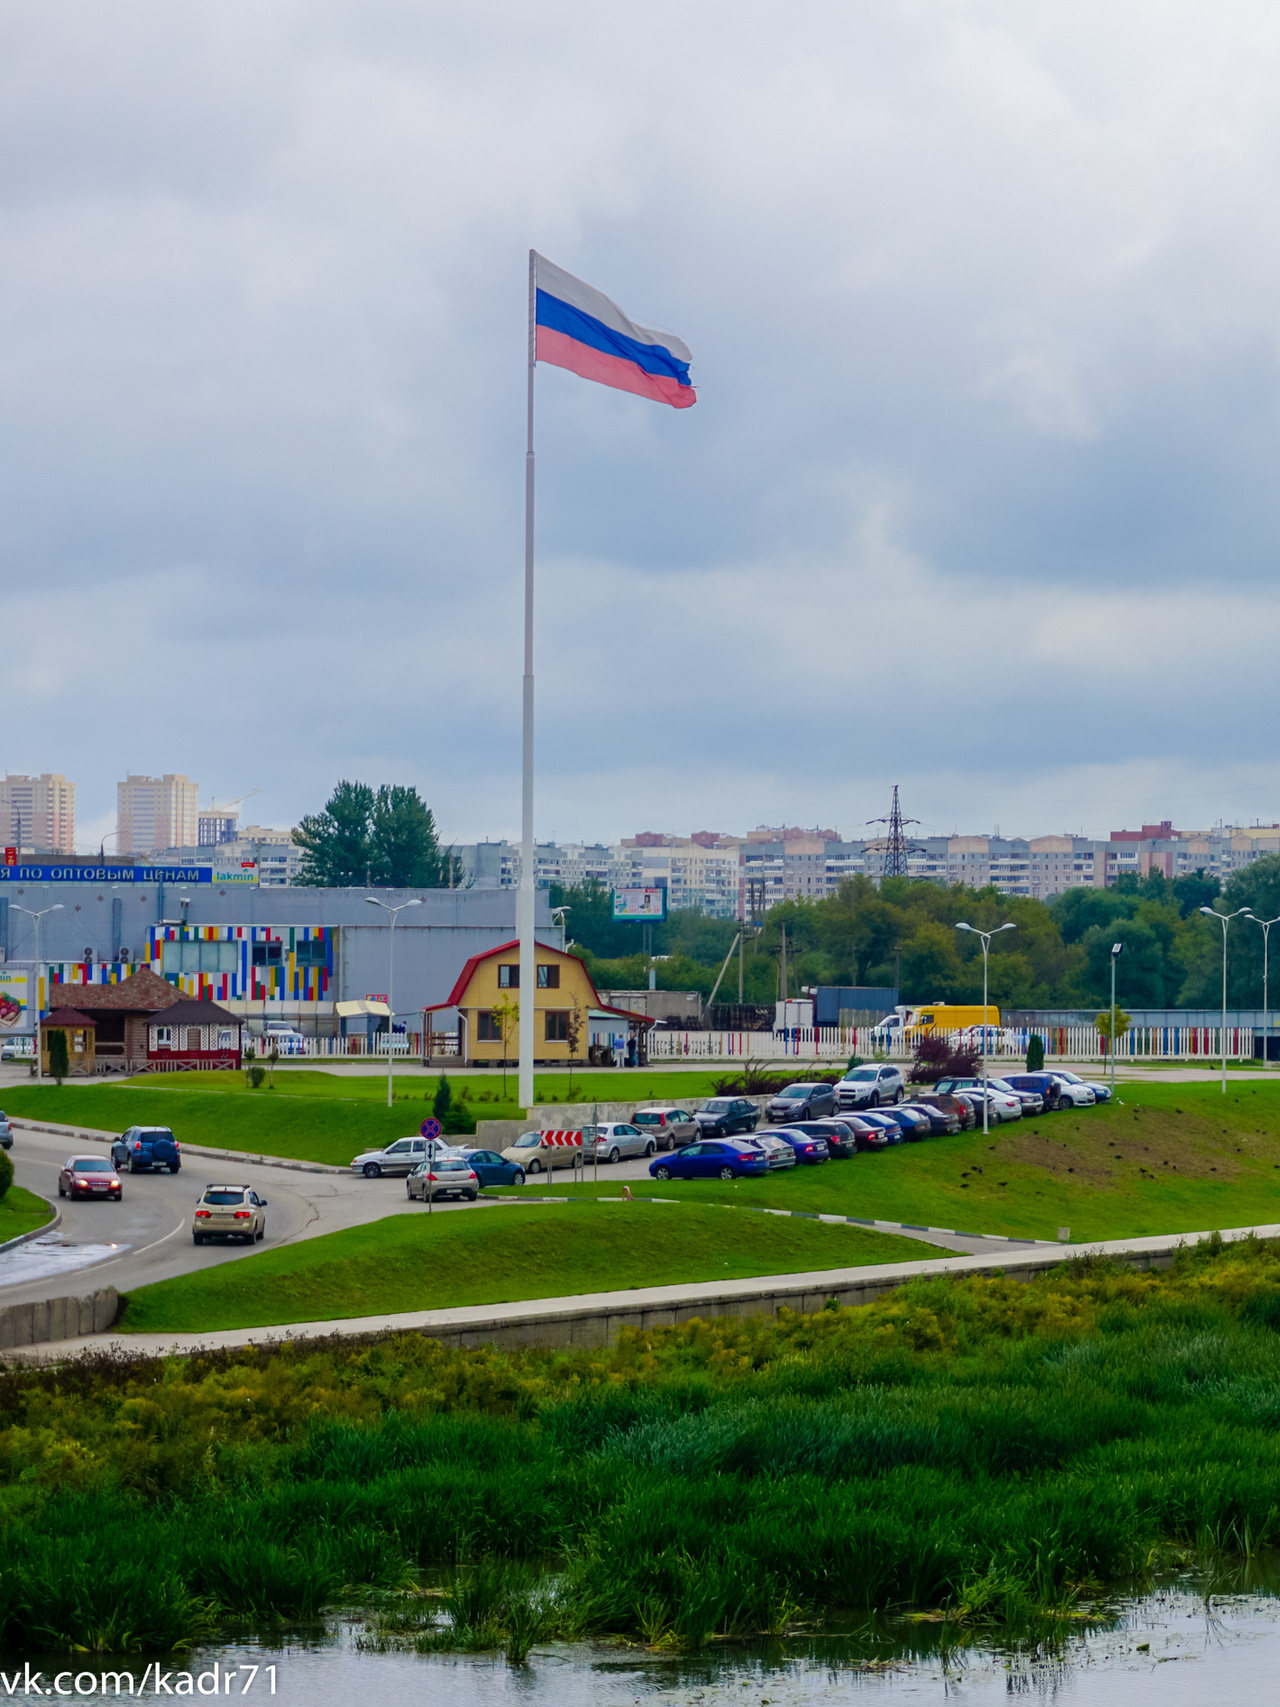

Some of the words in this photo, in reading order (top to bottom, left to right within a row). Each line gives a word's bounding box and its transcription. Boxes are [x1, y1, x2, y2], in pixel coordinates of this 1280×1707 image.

[20, 868, 42, 879] ПО
[51, 868, 134, 880] ОПТОВЫМ
[143, 870, 199, 882] ЦЕНАМ
[217, 869, 254, 881] lakmin
